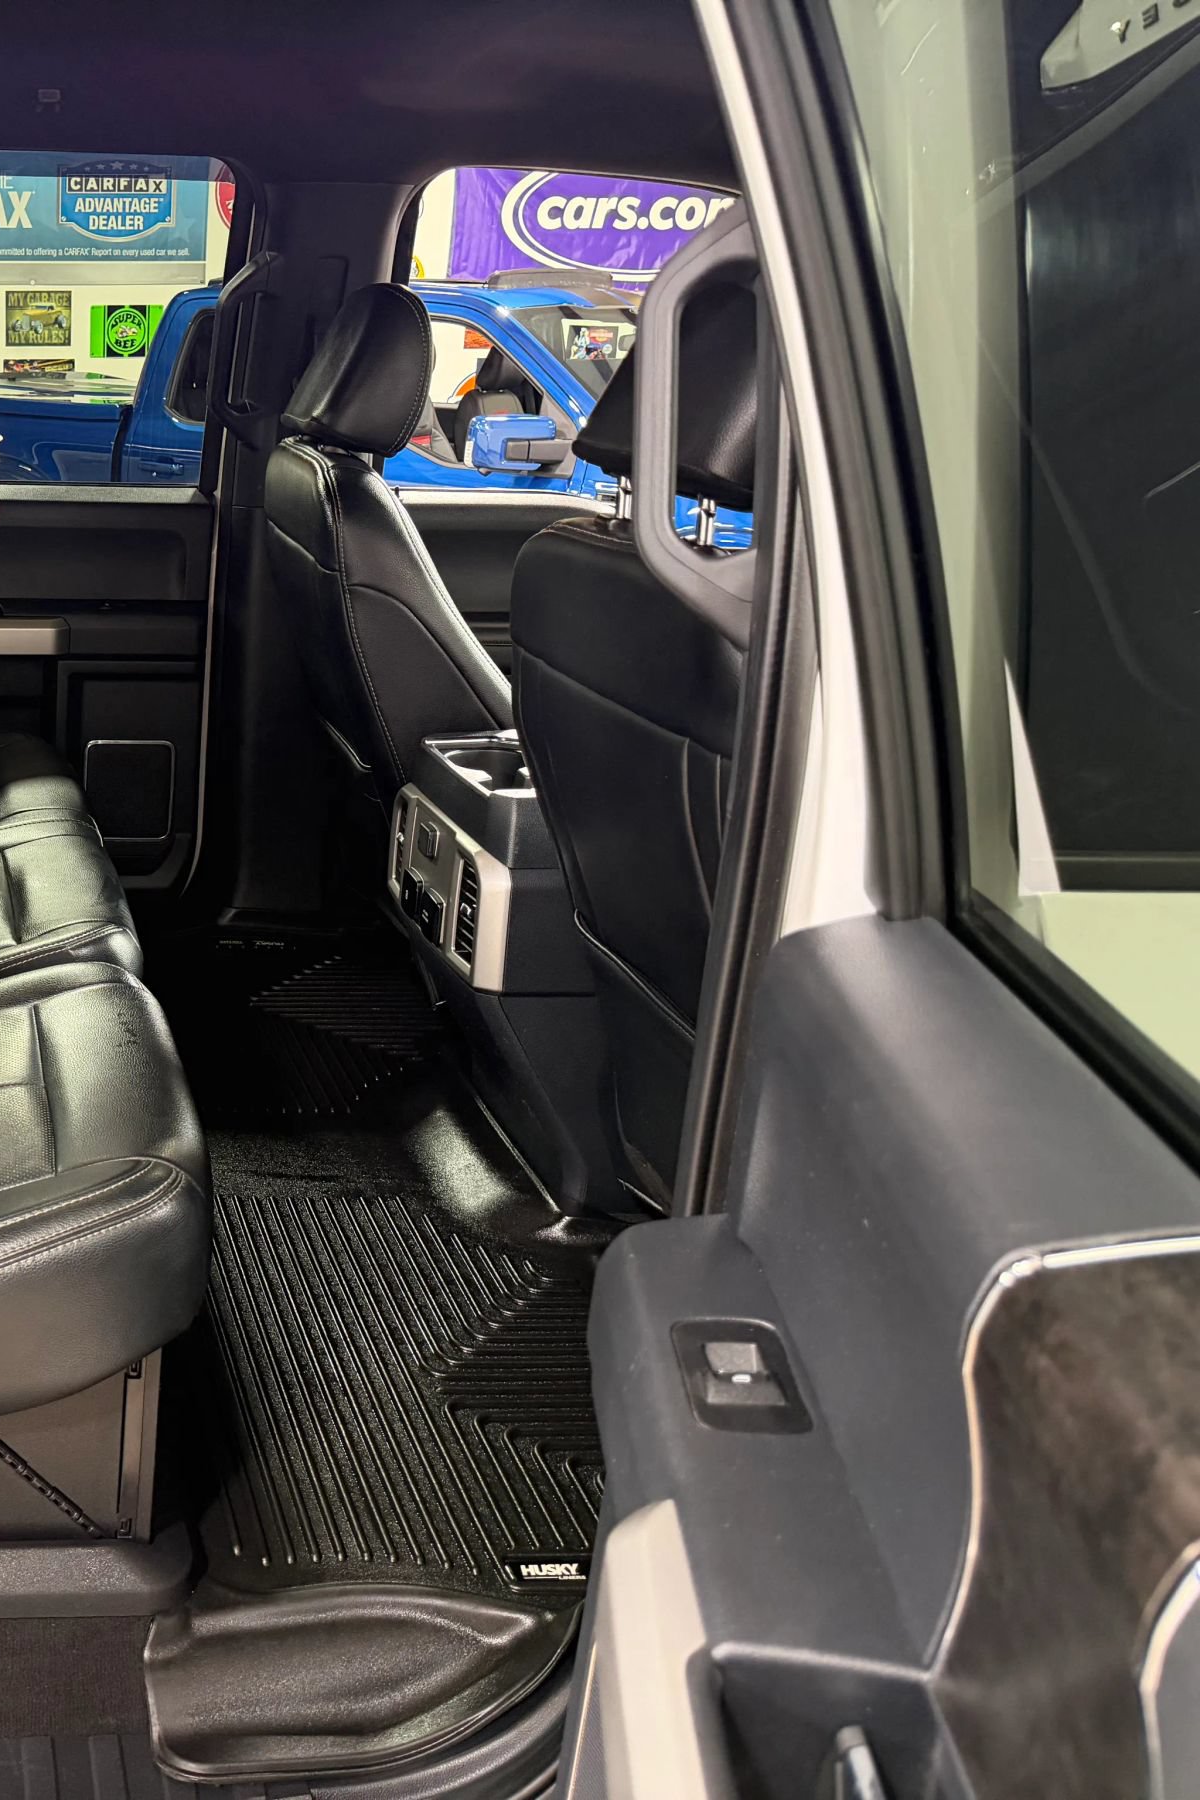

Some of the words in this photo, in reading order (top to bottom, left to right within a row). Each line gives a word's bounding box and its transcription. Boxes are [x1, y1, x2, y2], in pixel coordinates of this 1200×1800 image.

[69, 175, 164, 193] CARFAX
[74, 197, 160, 213] ADVANTAGE
[88, 215, 144, 230] DEALER
[34, 248, 57, 258] offering
[91, 248, 112, 258] Report
[122, 250, 138, 258] every
[140, 248, 155, 256] used
[8, 293, 25, 306] MY
[27, 292, 70, 306] GARAGE
[111, 313, 143, 330] SUPER
[8, 330, 26, 344] MY
[28, 330, 69, 344] RULES!
[114, 338, 137, 348] BEE
[520, 1562, 579, 1576] HUSKY
